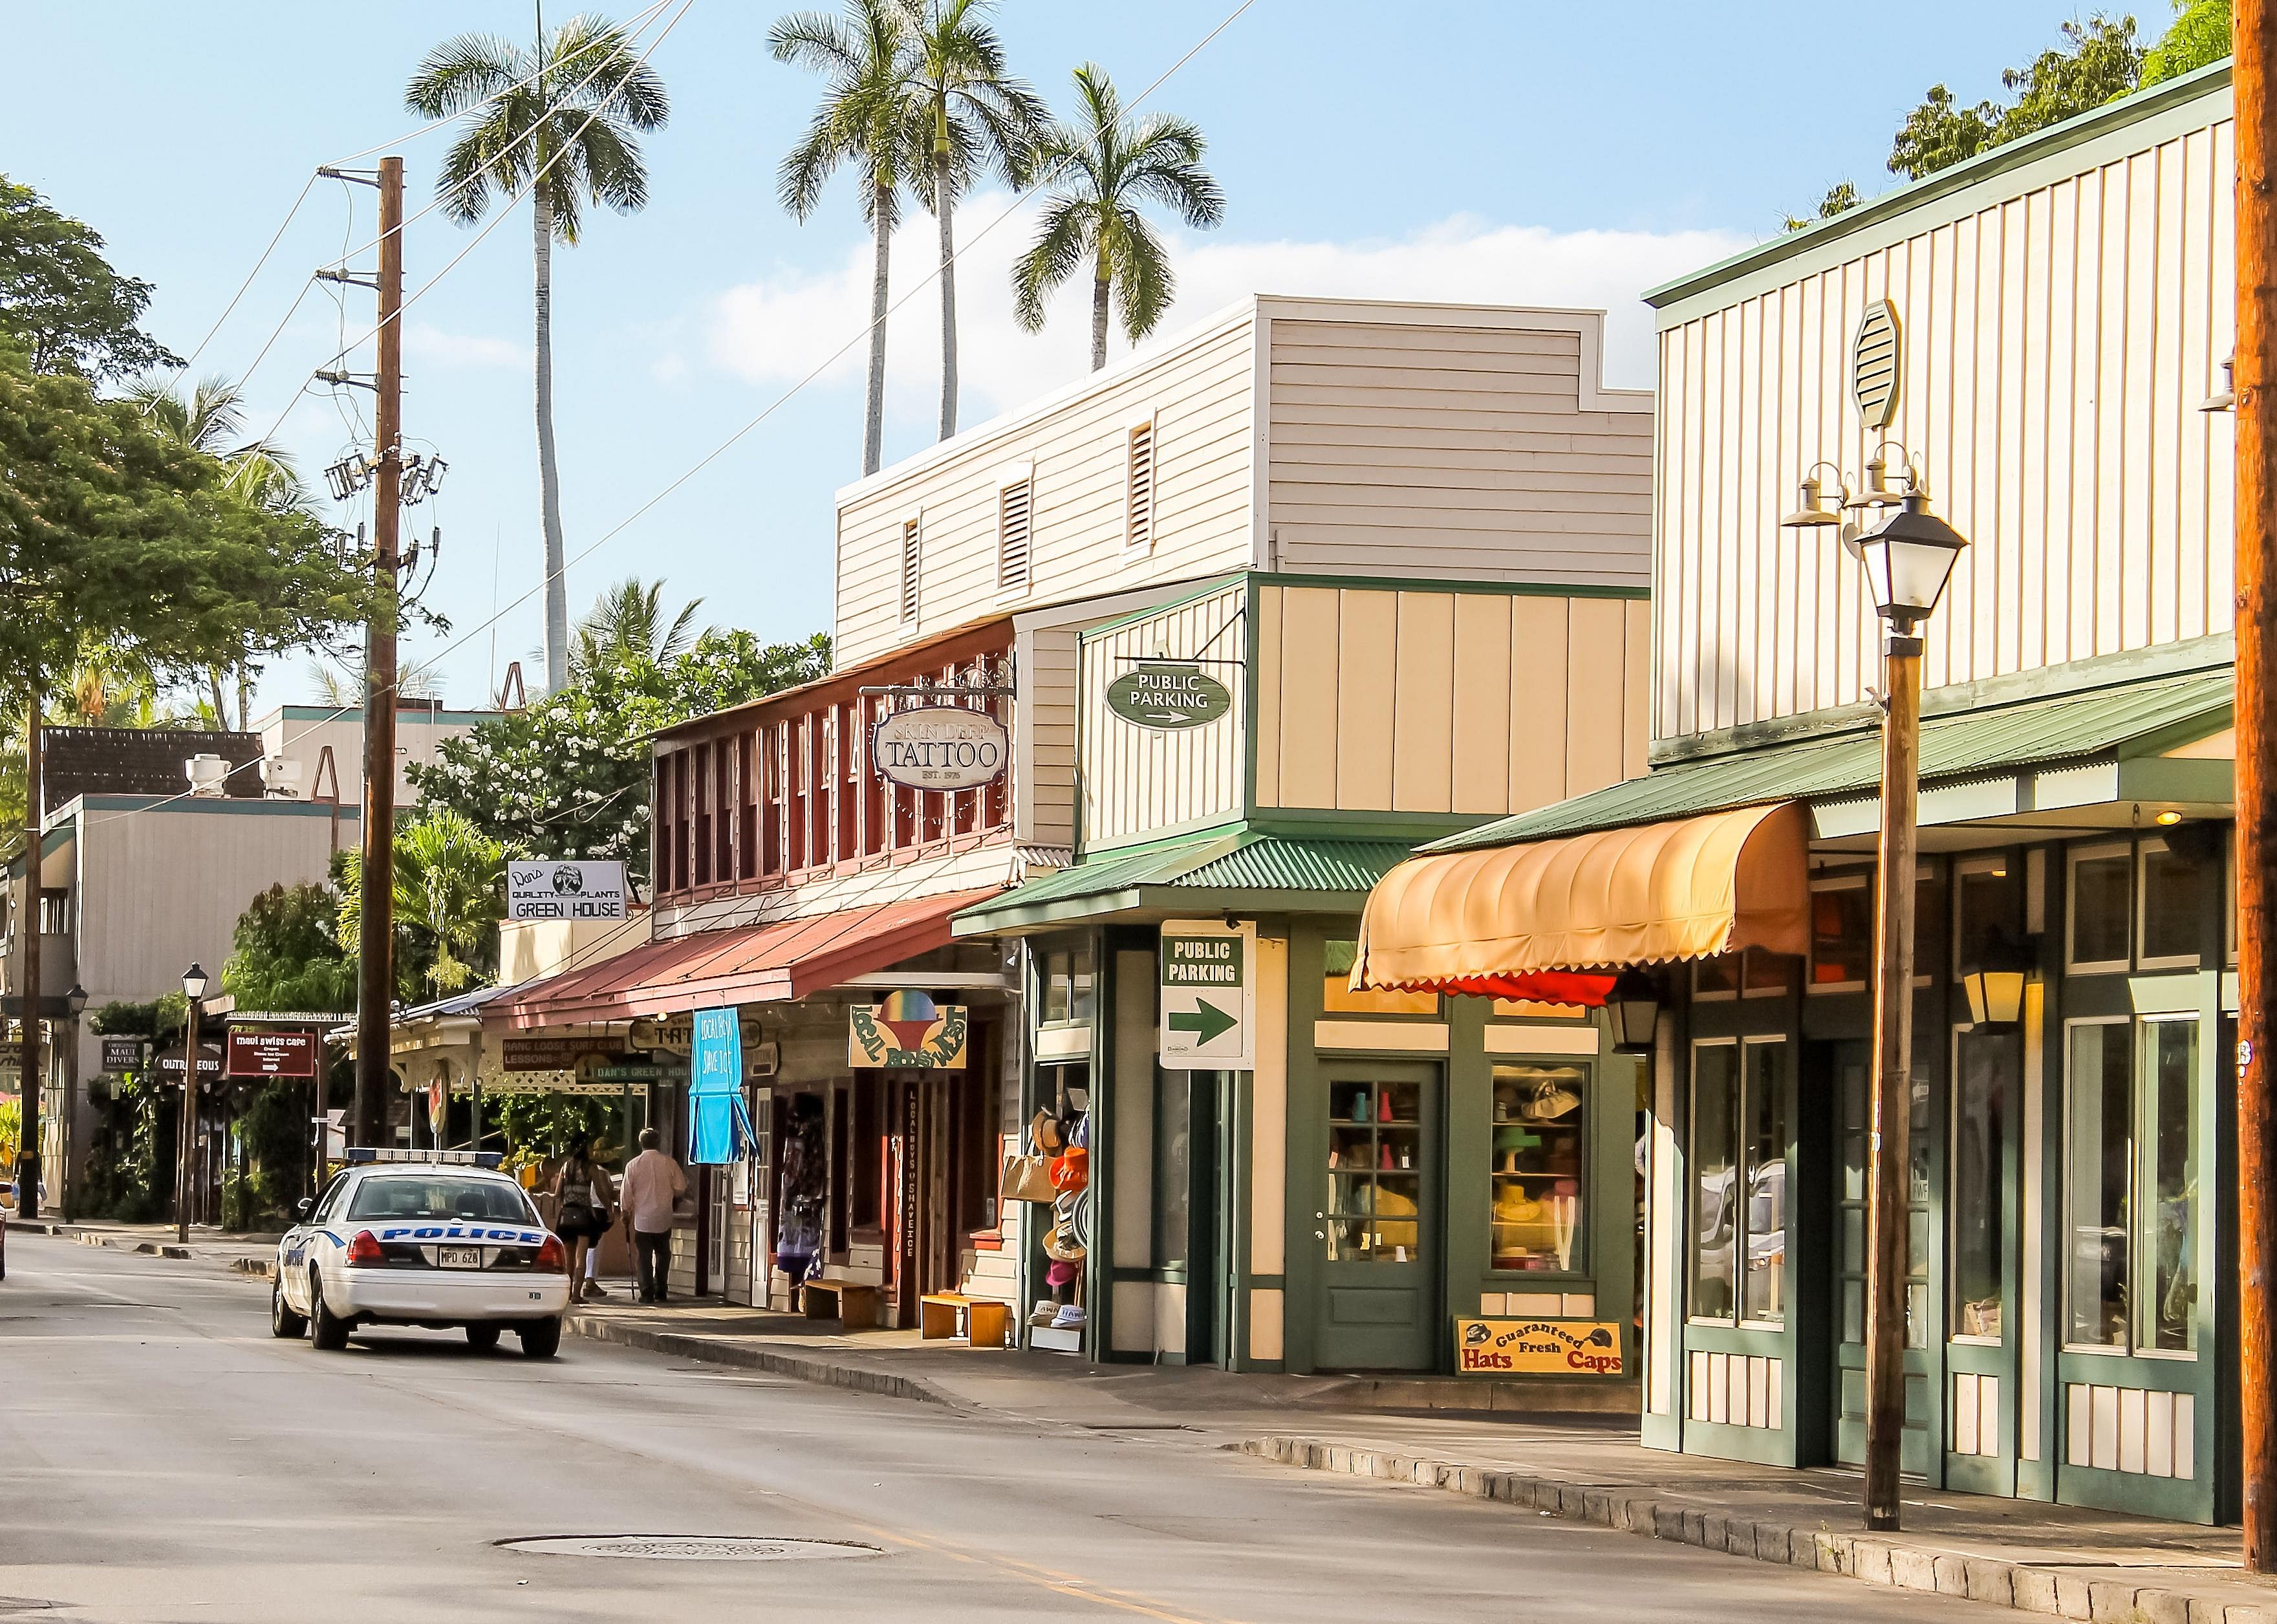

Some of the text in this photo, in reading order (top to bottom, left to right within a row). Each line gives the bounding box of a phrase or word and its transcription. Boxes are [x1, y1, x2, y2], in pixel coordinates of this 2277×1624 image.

[1138, 674, 1200, 691] PUBLIC
[1130, 691, 1208, 708] PARKING
[894, 723, 990, 740] SKIN DEEP
[885, 742, 998, 768] TATTOO
[922, 771, 942, 779] EST.
[512, 869, 545, 888] Dan's
[517, 902, 620, 917] GREEN HOUSE
[1174, 942, 1230, 959] PUBLIC
[1169, 964, 1235, 982] PARKING
[702, 1018, 718, 1041] LOCAL
[852, 1006, 886, 1063] LOCAL
[237, 1036, 258, 1045] maui
[260, 1036, 285, 1046] swiss
[504, 1039, 622, 1052] HANG LOOSE SURF CLUB
[162, 1059, 219, 1071] OUTREOUS
[598, 1067, 690, 1077] DAN'S GREEN HOU
[380, 1227, 543, 1244] POLICE
[1496, 1323, 1584, 1350] Guaranteed
[1518, 1342, 1562, 1353] Fresh
[1462, 1348, 1623, 1374] Hats Caps
